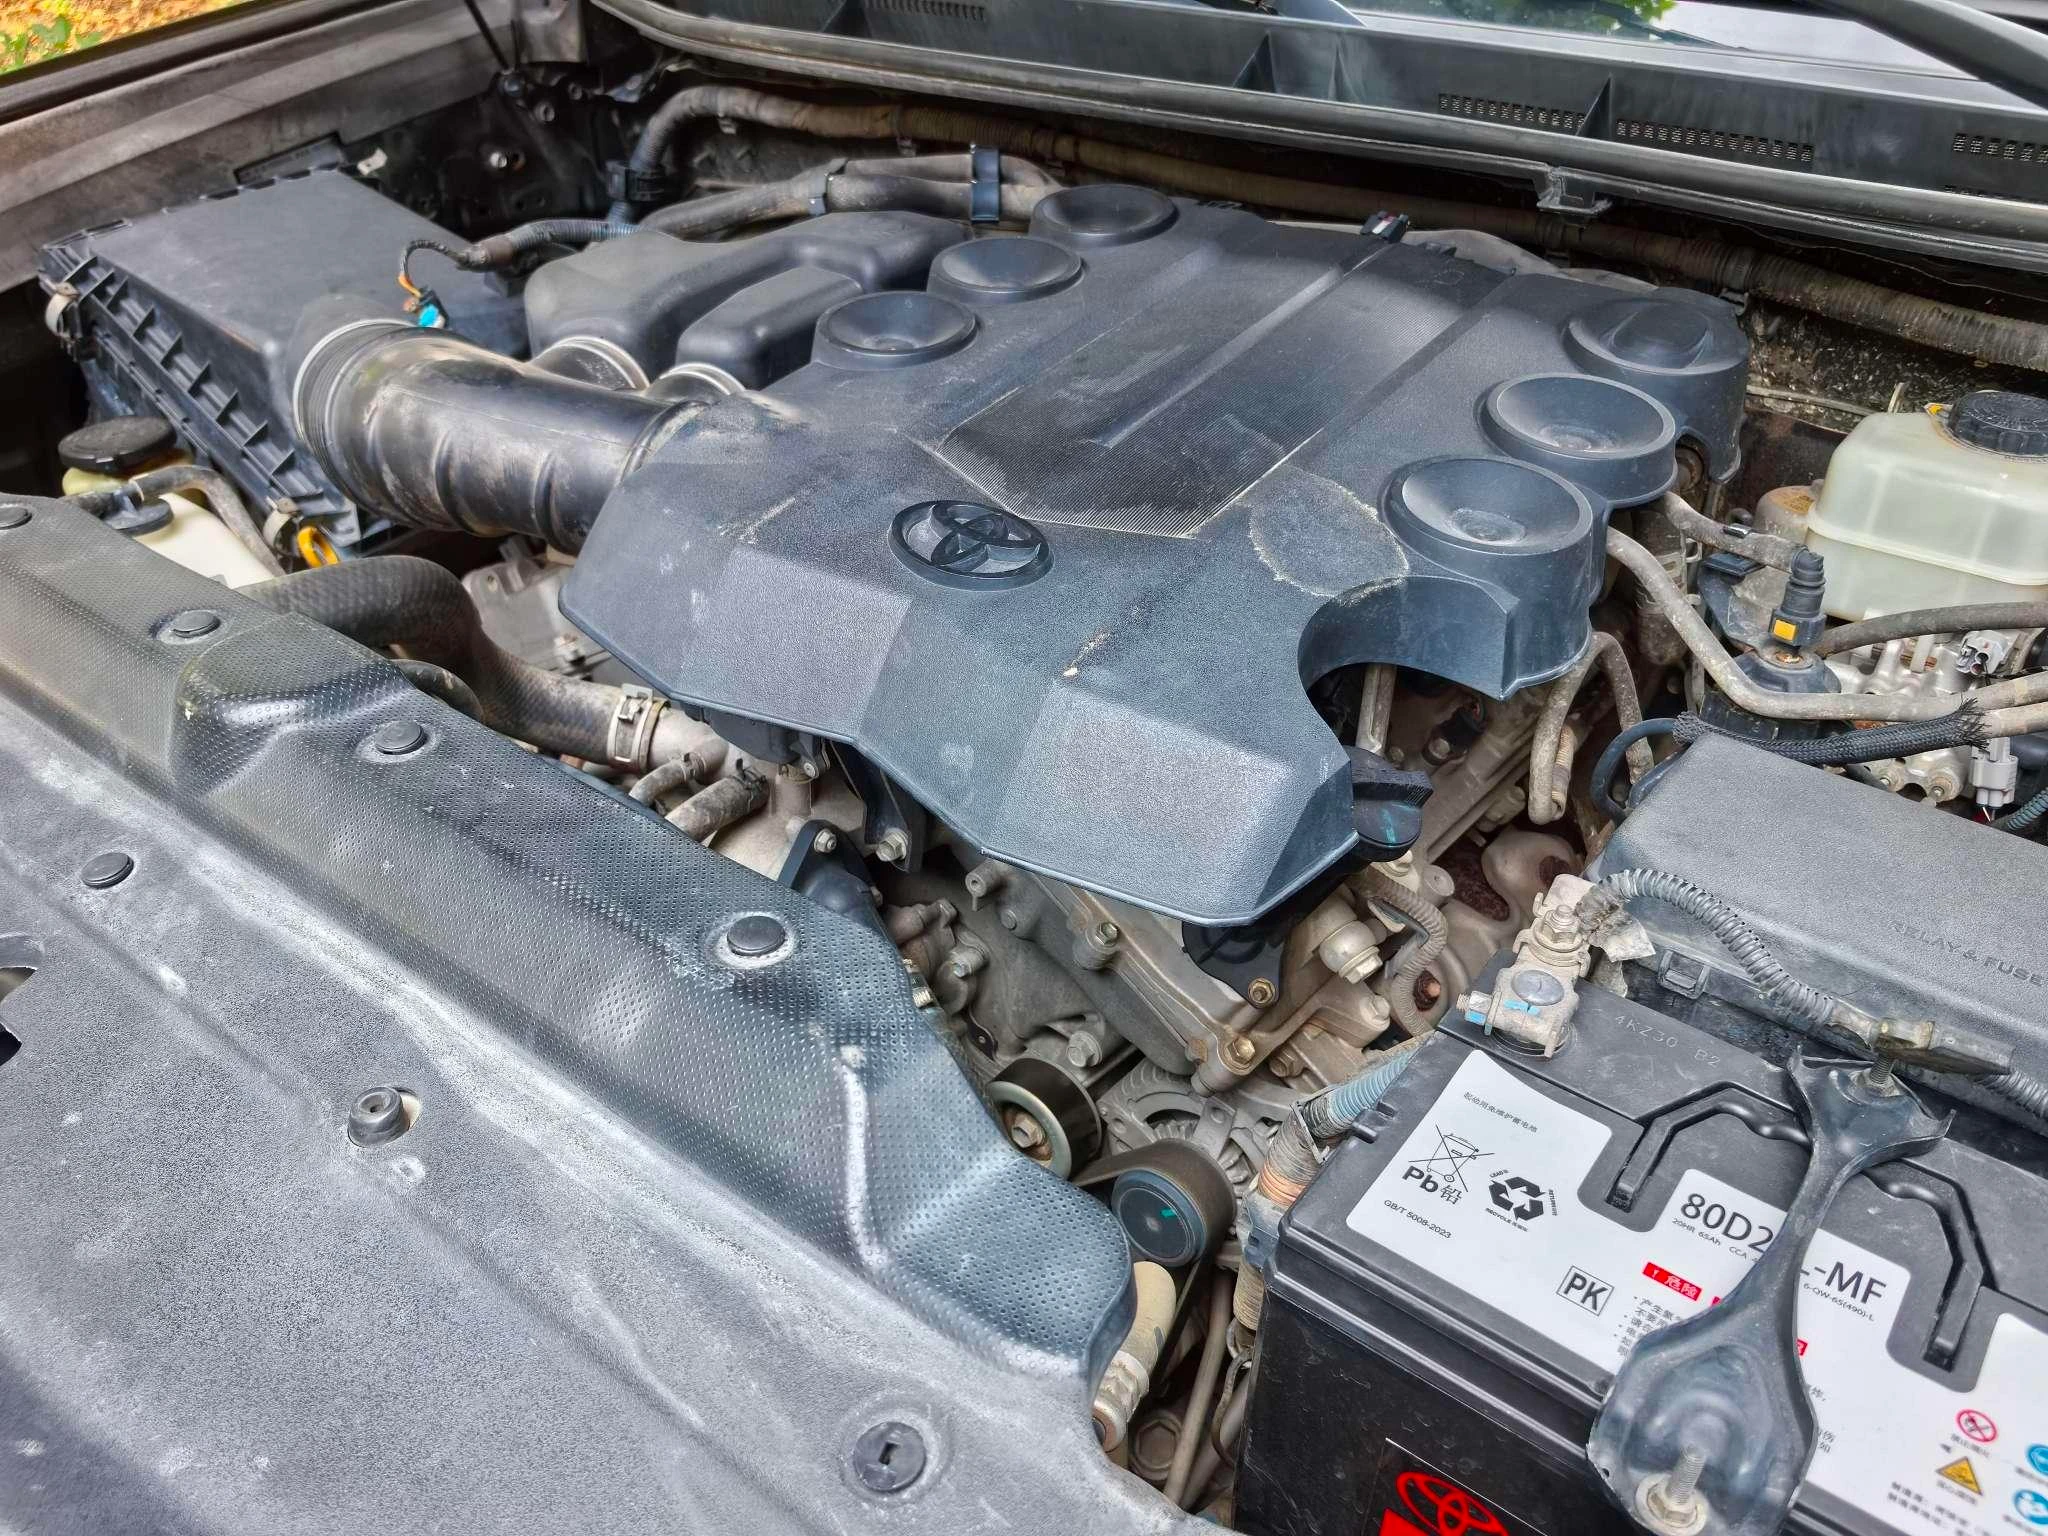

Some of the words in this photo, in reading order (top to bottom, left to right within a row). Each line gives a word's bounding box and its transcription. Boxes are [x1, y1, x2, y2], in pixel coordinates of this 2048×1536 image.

[1984, 957, 2043, 986] FUSE
[1402, 1165, 1439, 1193] Pb
[1440, 1184, 1464, 1205] 铅
[1384, 1200, 1407, 1217] GB/T
[1407, 1211, 1452, 1239] 5008-2023
[1698, 1231, 1721, 1246] 65Ah
[1729, 1246, 1748, 1260] CCA
[1563, 1272, 1609, 1311] PK
[1664, 1274, 1700, 1299] 危险
